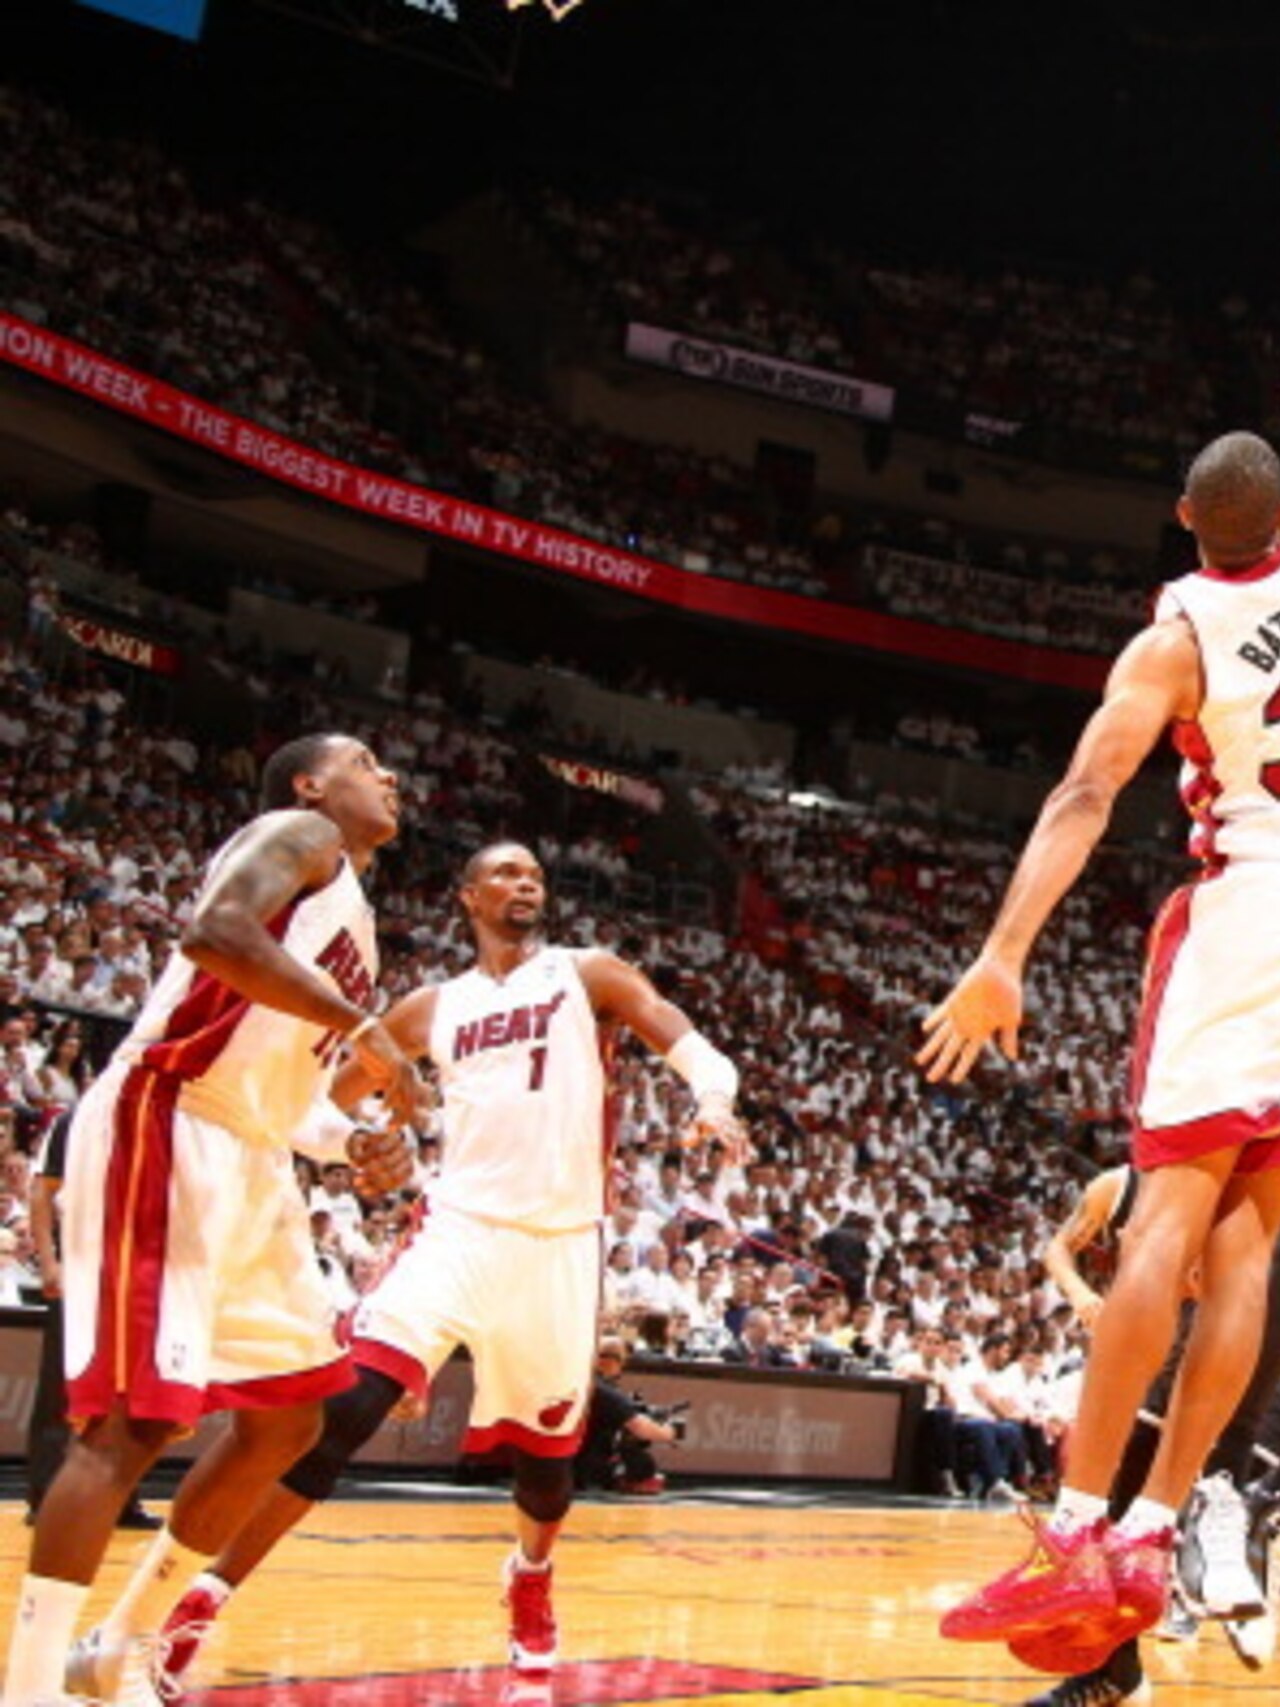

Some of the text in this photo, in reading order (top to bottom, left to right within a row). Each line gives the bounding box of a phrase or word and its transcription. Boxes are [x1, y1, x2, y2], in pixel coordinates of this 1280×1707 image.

[64, 348, 149, 411] WEEK
[179, 400, 231, 445] THE
[236, 426, 347, 493] BIGGEST
[357, 476, 444, 527] WEEK
[453, 507, 484, 538] IN
[493, 521, 530, 549] TV
[534, 534, 651, 587] HISTORY
[453, 989, 566, 1061] HEAT
[529, 1046, 548, 1091] 1
